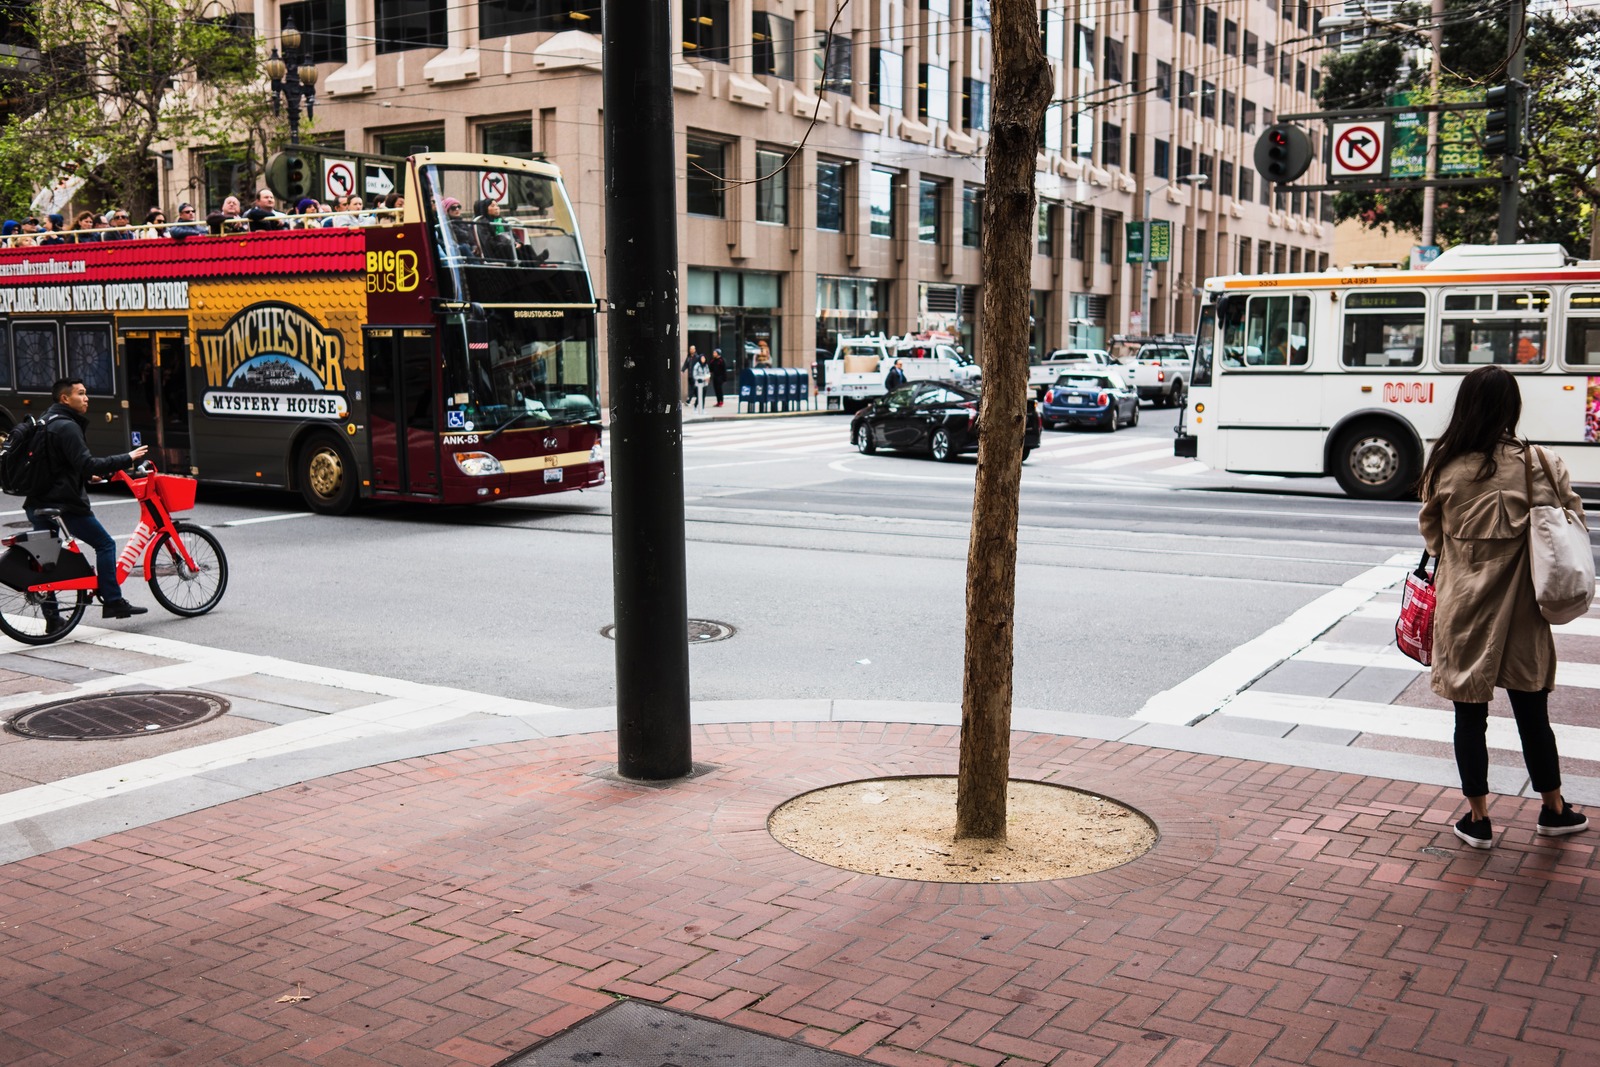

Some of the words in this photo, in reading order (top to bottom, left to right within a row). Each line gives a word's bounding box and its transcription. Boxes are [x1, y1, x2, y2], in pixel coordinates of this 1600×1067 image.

[366, 250, 396, 273] BIG
[1424, 249, 1437, 259] 49
[367, 272, 396, 293] BUS
[37, 285, 72, 311] ROOMS
[72, 284, 105, 311] NEVER
[105, 283, 146, 310] OPENED
[147, 281, 189, 309] BEFORE
[513, 310, 565, 318] BIGBUSTOURS.COM
[200, 307, 346, 391] WINCHESTER
[212, 395, 280, 411] MYSTERY
[286, 397, 337, 414] HOUSE
[443, 434, 479, 445] ANK-53
[116, 521, 151, 573] JUMP
